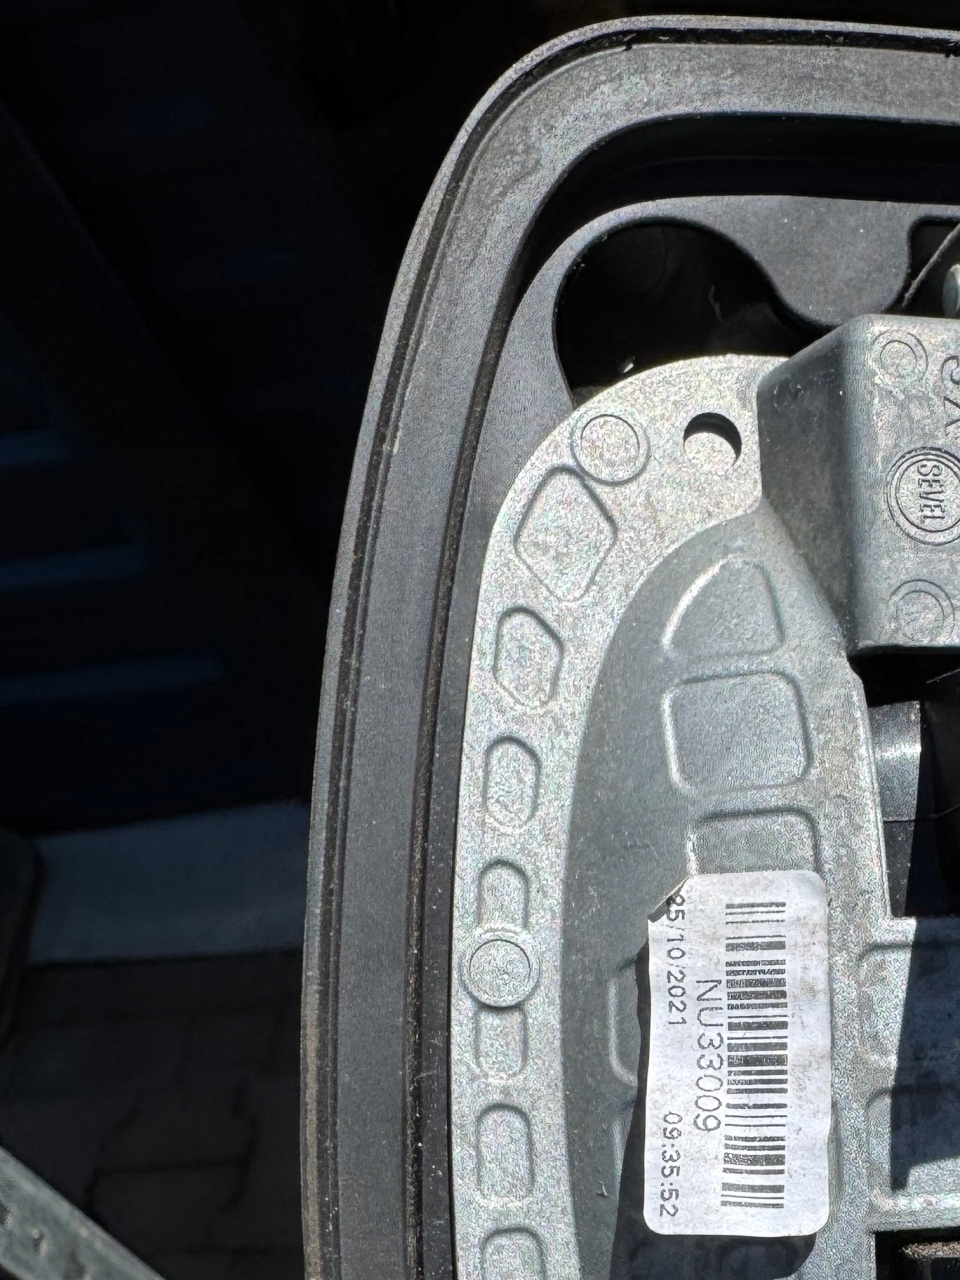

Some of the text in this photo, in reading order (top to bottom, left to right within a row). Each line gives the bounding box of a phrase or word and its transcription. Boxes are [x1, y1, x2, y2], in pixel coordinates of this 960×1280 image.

[916, 462, 947, 523] SEVEL
[659, 894, 687, 1218] 25/10/2021 09:35:52
[693, 979, 724, 1132] NU33009
